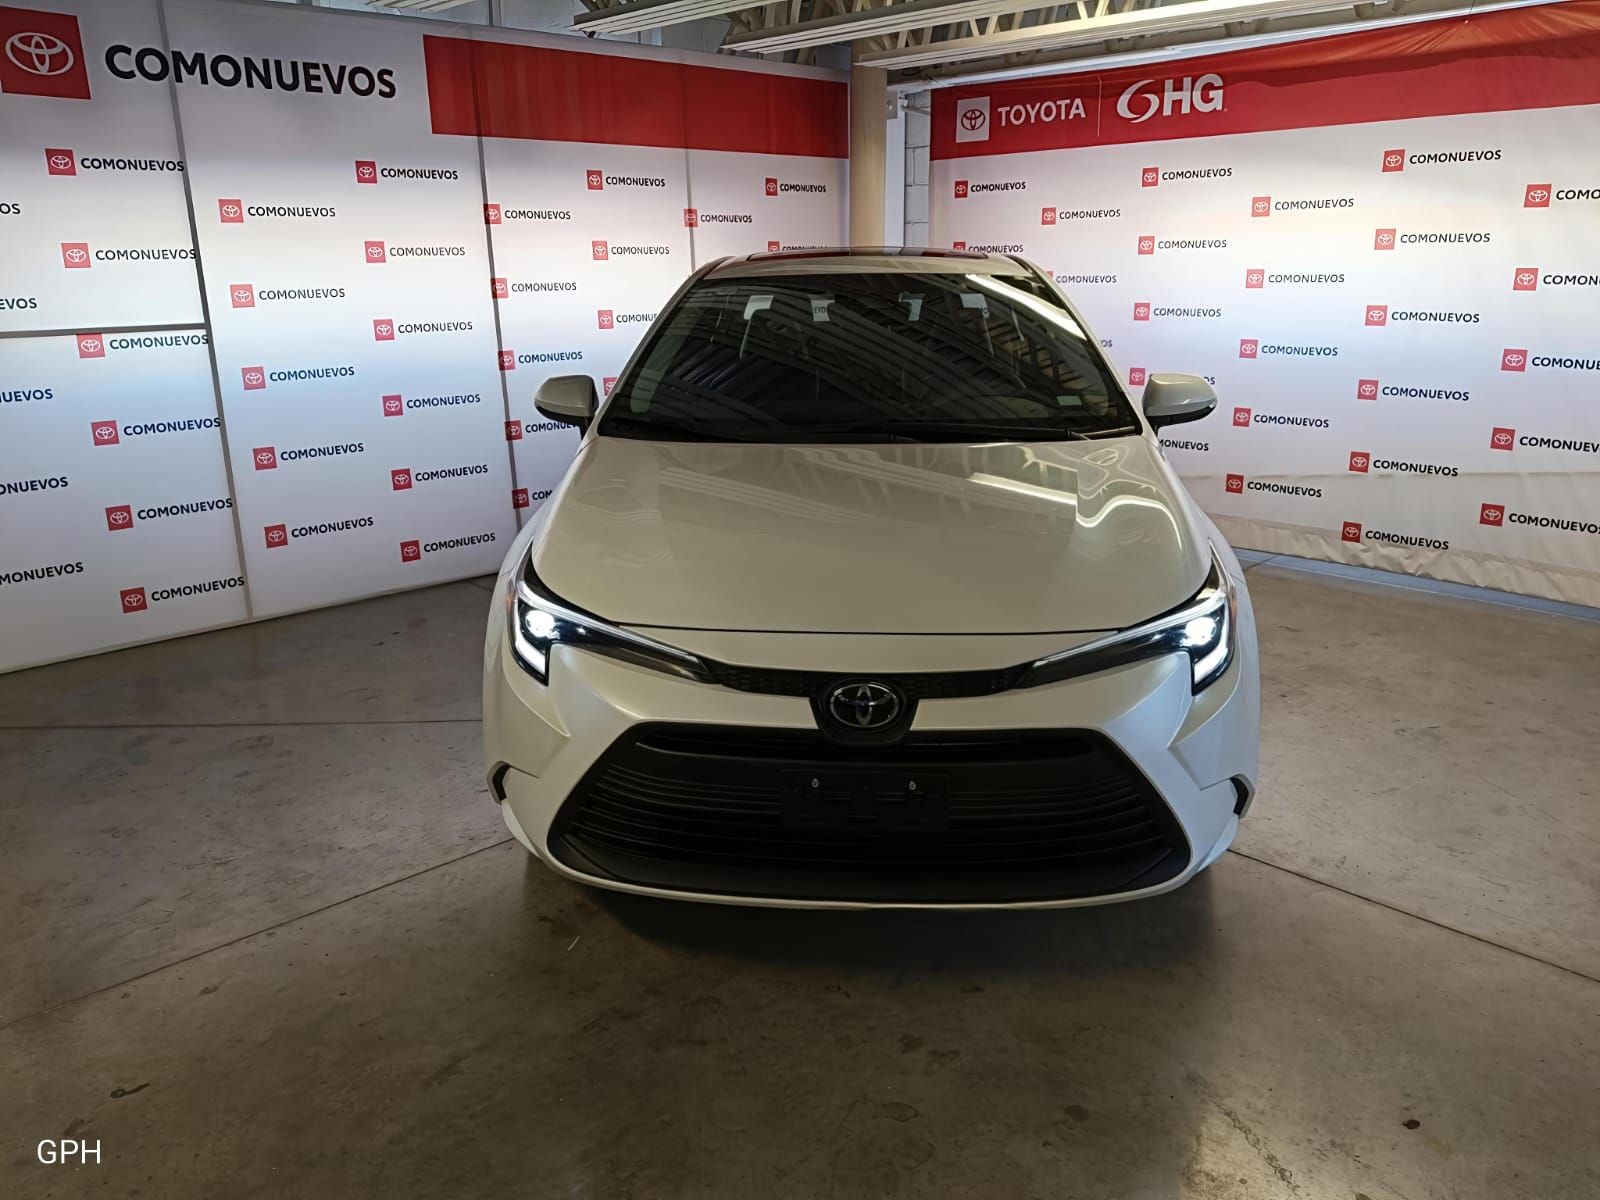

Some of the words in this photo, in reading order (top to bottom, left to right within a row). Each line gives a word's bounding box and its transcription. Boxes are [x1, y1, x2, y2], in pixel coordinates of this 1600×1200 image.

[105, 44, 396, 98] COMONUEVOS
[998, 98, 1086, 127] TOYOTA
[1409, 150, 1501, 165] COMONUEVOS
[81, 158, 184, 172] COMONUEVOS
[381, 168, 458, 180] COMONUEVOS
[1162, 168, 1232, 181] COMONUEVOS
[605, 176, 666, 187] COMONUEVOS
[970, 182, 1026, 193] COMONUEVOS
[779, 183, 826, 194] COMONUEVOS
[1274, 198, 1354, 211] COMONUEVOS
[247, 206, 336, 218] COMONUEVOS
[504, 210, 571, 220] COMONUEVOS
[700, 213, 752, 224] COMONUEVOS
[1059, 209, 1121, 220] COMONUEVOS
[1158, 240, 1227, 250] COMONUEVOS
[1400, 233, 1491, 244] COMONUEVOS
[95, 248, 196, 261] COMONUEVOS
[389, 247, 466, 257] COMONUEVOS
[611, 246, 671, 255] COMONUEVOS
[1056, 275, 1117, 285] COMONUEVOS
[1268, 274, 1345, 284] COMONUEVOS
[511, 282, 577, 293] COMONUEVOS
[258, 288, 345, 301] COMONUEVOS
[1153, 307, 1222, 318] COMONUEVOS
[1391, 311, 1480, 324] COMONUEVOS
[398, 322, 473, 334] COMONUEVOS
[109, 334, 209, 350] COMONUEVOS
[518, 351, 583, 364] COMONUEVOS
[1261, 345, 1338, 357] COMONUEVOS
[269, 366, 355, 382] COMONUEVOS
[1382, 386, 1470, 402] COMONUEVOS
[406, 394, 481, 409] COMONUEVOS
[123, 417, 221, 437] COMONUEVOS
[1254, 414, 1329, 428] COMONUEVOS
[1519, 436, 1600, 453] COMONUEV
[280, 443, 364, 461] COMONUEVOS
[415, 464, 488, 482] COMONUEVOS
[1373, 459, 1459, 477] COMONUEVOS
[1247, 481, 1322, 498] COMONUEVOS
[137, 498, 233, 521] COMONUEVOS
[291, 517, 374, 538] COMONUEVOS
[424, 533, 496, 553] COMONUEVOS
[1365, 530, 1449, 551] COMONUEVOS
[151, 577, 245, 602] COMONUEVOS
